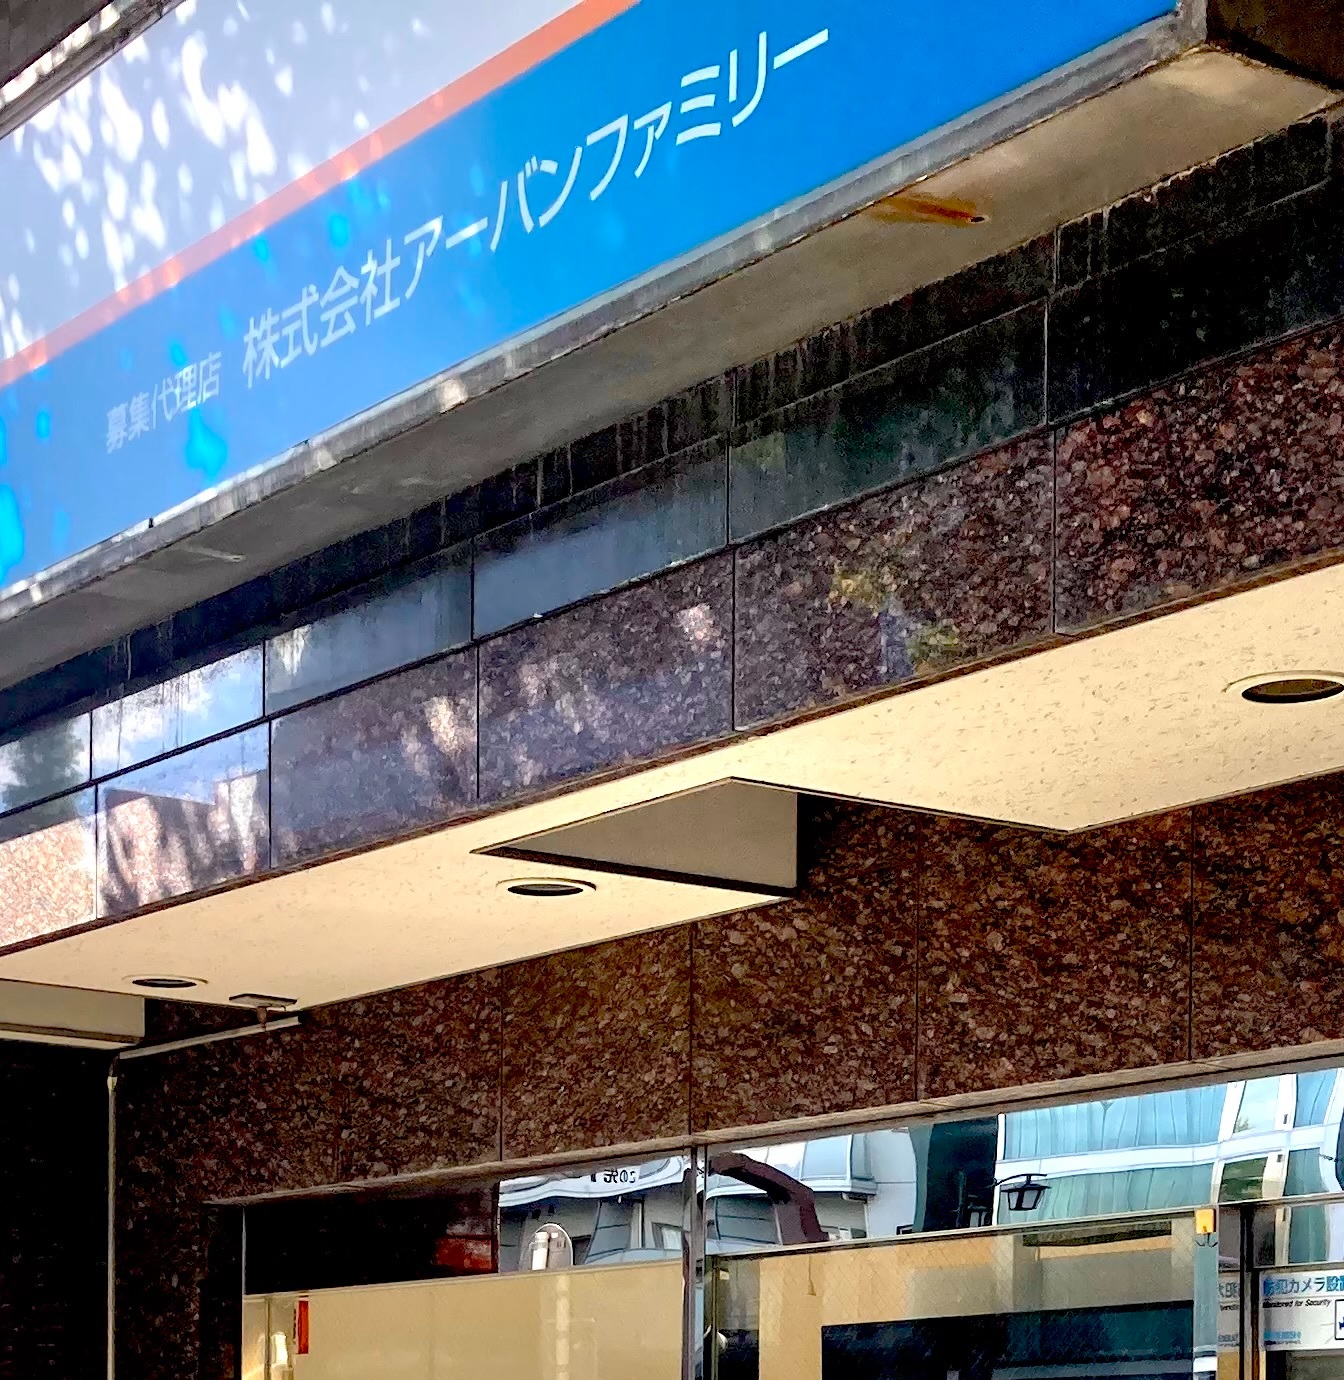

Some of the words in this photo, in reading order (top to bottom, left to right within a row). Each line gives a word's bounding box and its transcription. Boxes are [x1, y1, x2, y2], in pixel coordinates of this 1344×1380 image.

[106, 351, 222, 454] 募集代理店
[243, 28, 829, 389] 株式会社アーバンファミリー
